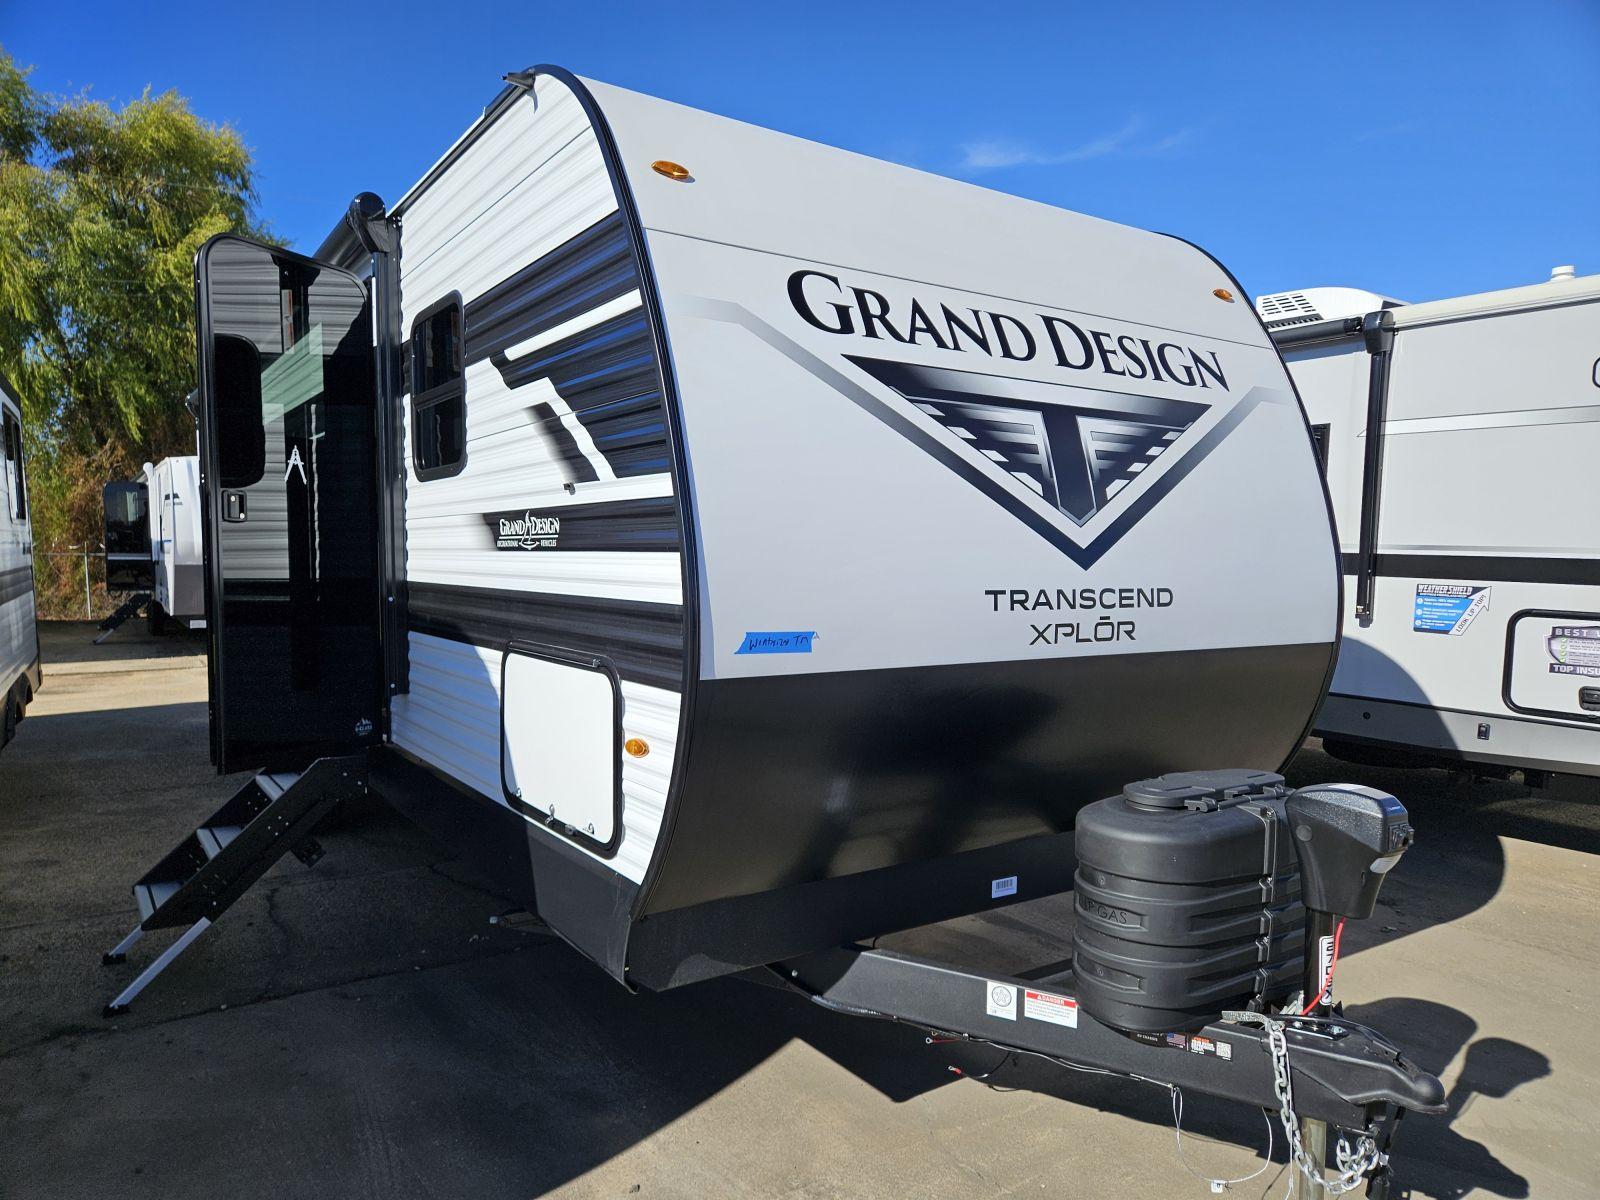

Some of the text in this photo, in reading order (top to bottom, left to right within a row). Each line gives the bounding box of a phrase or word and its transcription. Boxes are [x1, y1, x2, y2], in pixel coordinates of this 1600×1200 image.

[786, 269, 1230, 392] GRAND DESIGN
[499, 516, 560, 535] GRAND DESIGN
[984, 587, 1174, 612] TRANSCEND
[1555, 628, 1588, 637] BEST
[1097, 904, 1128, 925] GAS
